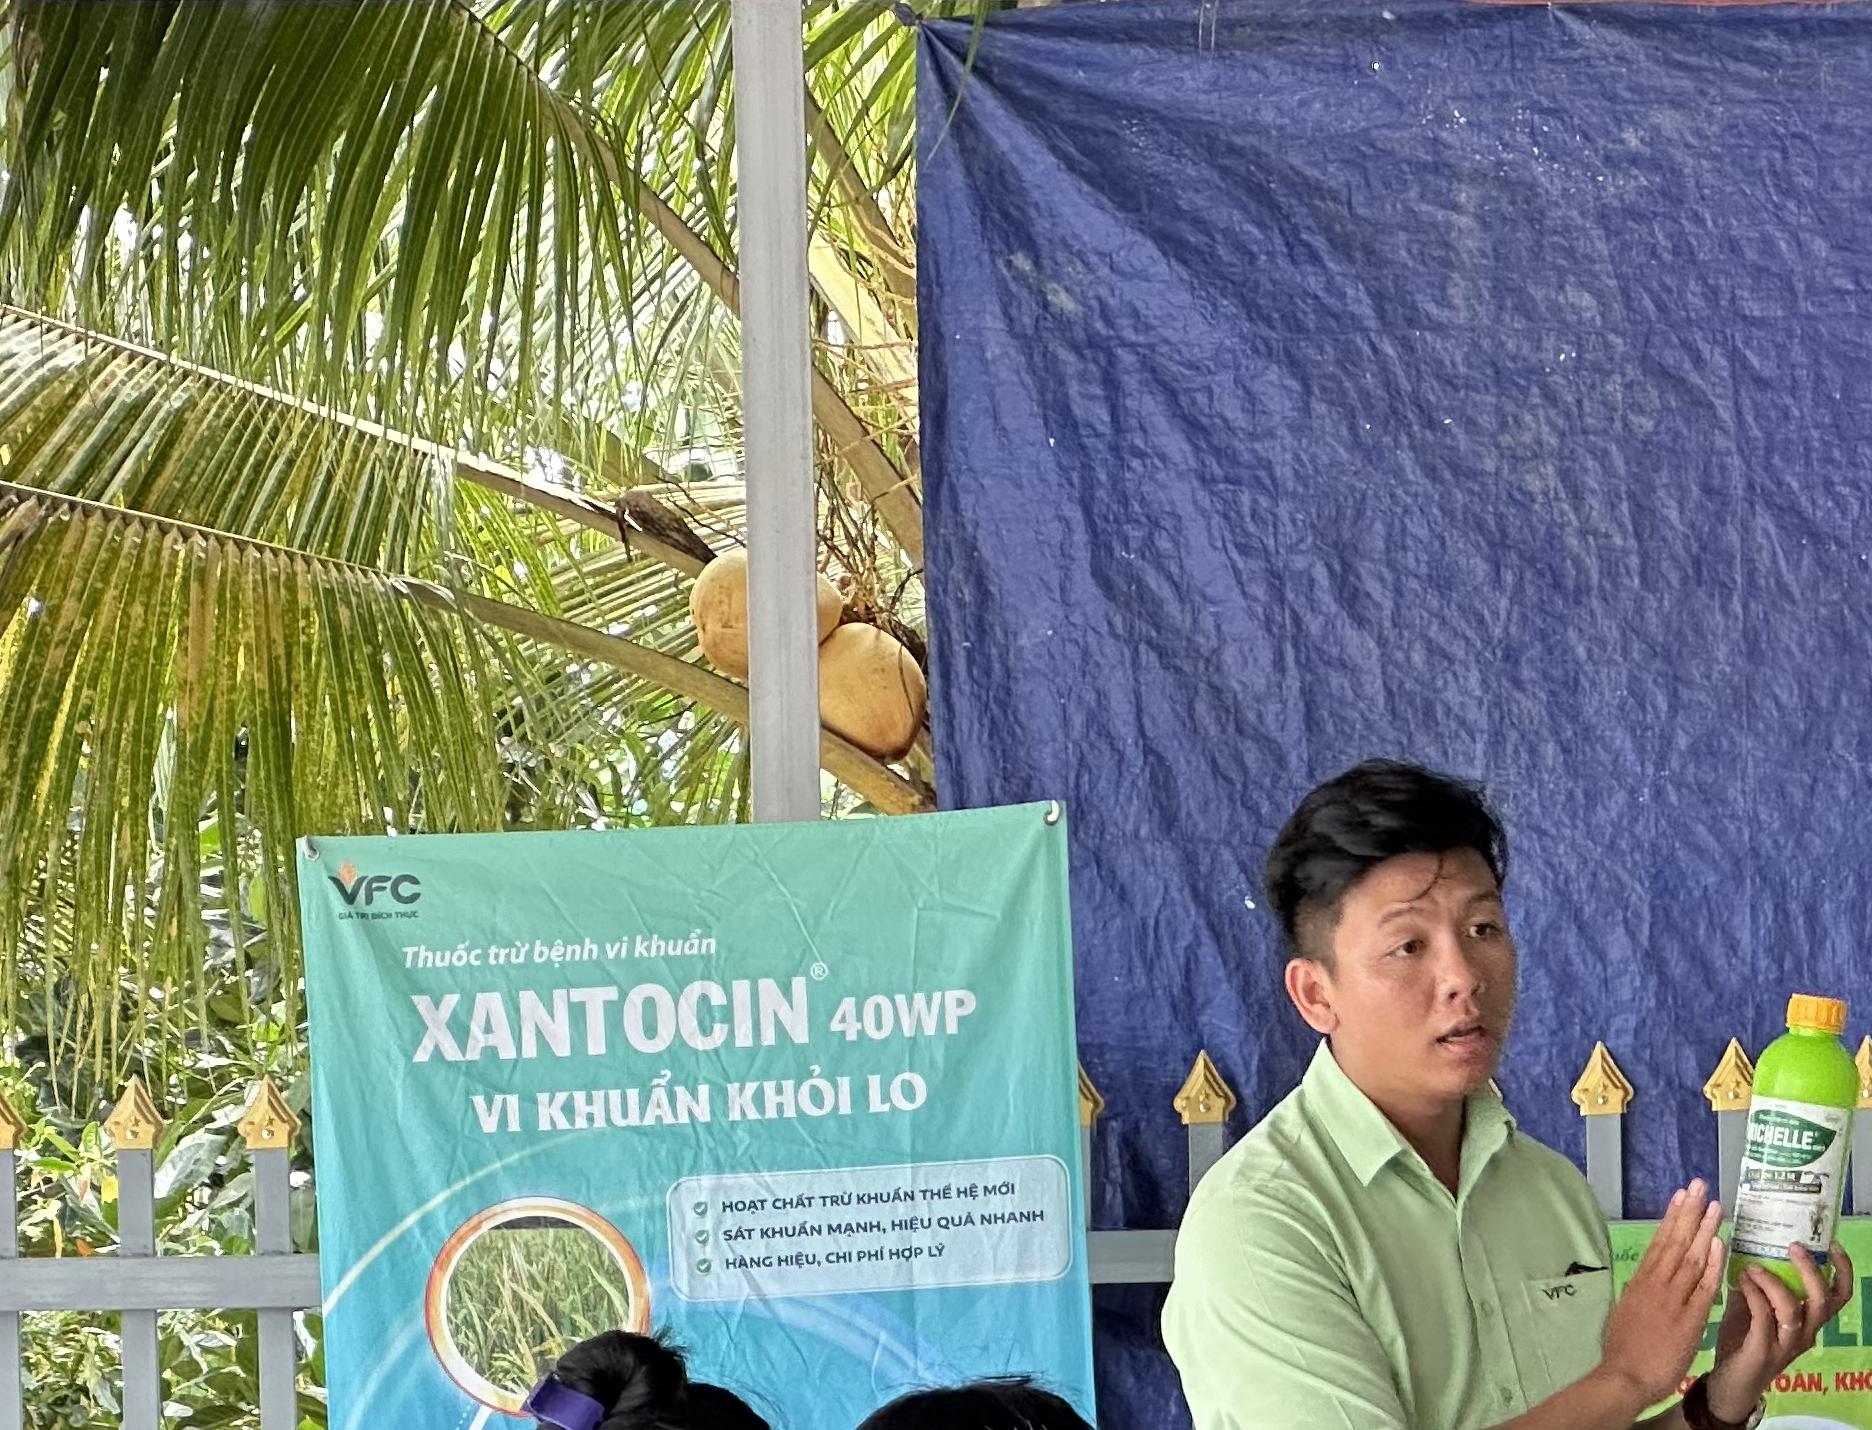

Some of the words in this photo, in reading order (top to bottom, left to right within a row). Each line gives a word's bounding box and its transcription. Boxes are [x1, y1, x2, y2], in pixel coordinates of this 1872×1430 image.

[327, 873, 422, 906] VFC
[402, 939, 483, 968] Thuốc
[487, 942, 530, 965] trừ
[532, 937, 599, 967] bệnh
[605, 936, 627, 959] vi
[830, 990, 976, 1042] 40WP
[471, 1095, 521, 1134] VI
[536, 1070, 711, 1132] KHUẨN
[727, 1065, 851, 1120] KHỎI
[868, 1071, 928, 1112] LO
[722, 1199, 767, 1215] HOẠT
[956, 1183, 978, 1200] HỆ
[983, 1181, 1015, 1197] MỚI
[723, 1226, 755, 1241] SÁT
[891, 1216, 932, 1233] HIỆU
[937, 1212, 976, 1230] QUẢ
[980, 1210, 1044, 1225] NHANH
[725, 1254, 773, 1270] HÀNG
[825, 1251, 853, 1264] CHI
[857, 1246, 884, 1262] PHÍ
[889, 1246, 923, 1262] HỢP
